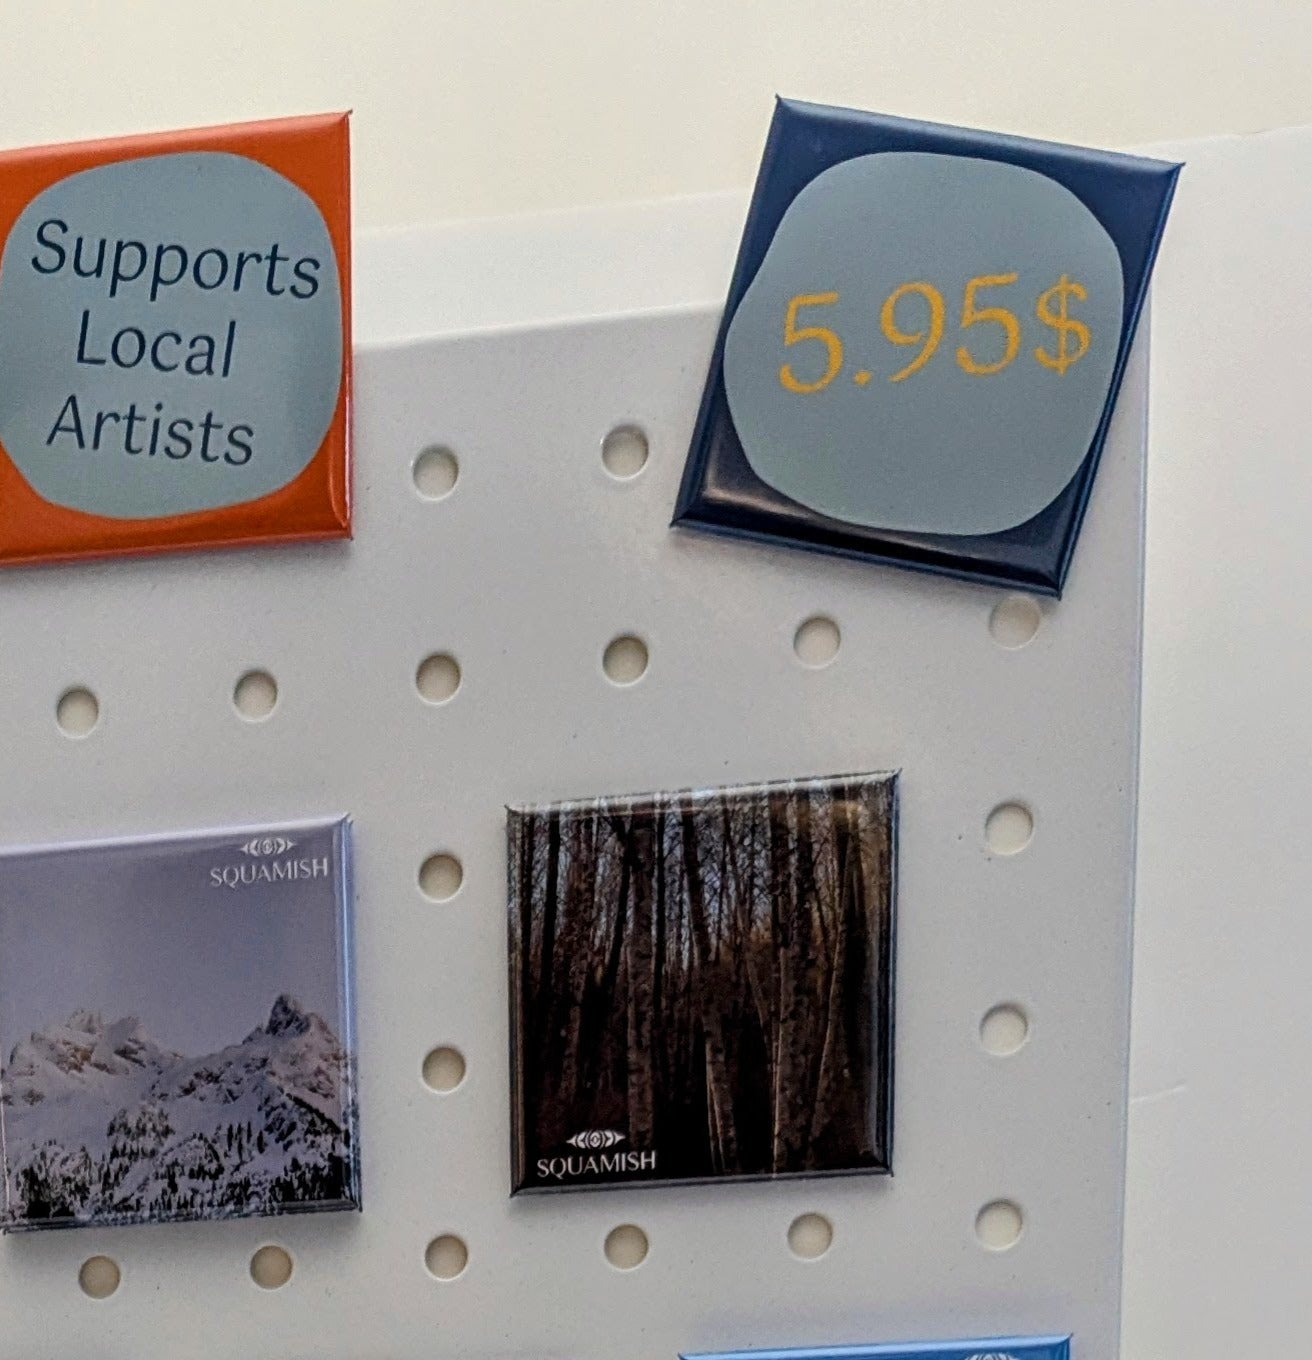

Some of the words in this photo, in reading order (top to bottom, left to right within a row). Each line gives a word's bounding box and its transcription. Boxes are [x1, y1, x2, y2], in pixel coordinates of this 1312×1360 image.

[29, 217, 323, 300] Supports
[75, 310, 236, 379] Local
[776, 272, 1093, 394] 5.95$
[44, 393, 255, 468] Artists
[210, 858, 329, 887] SQUAMISH
[536, 1151, 656, 1179] SQUAMISH
